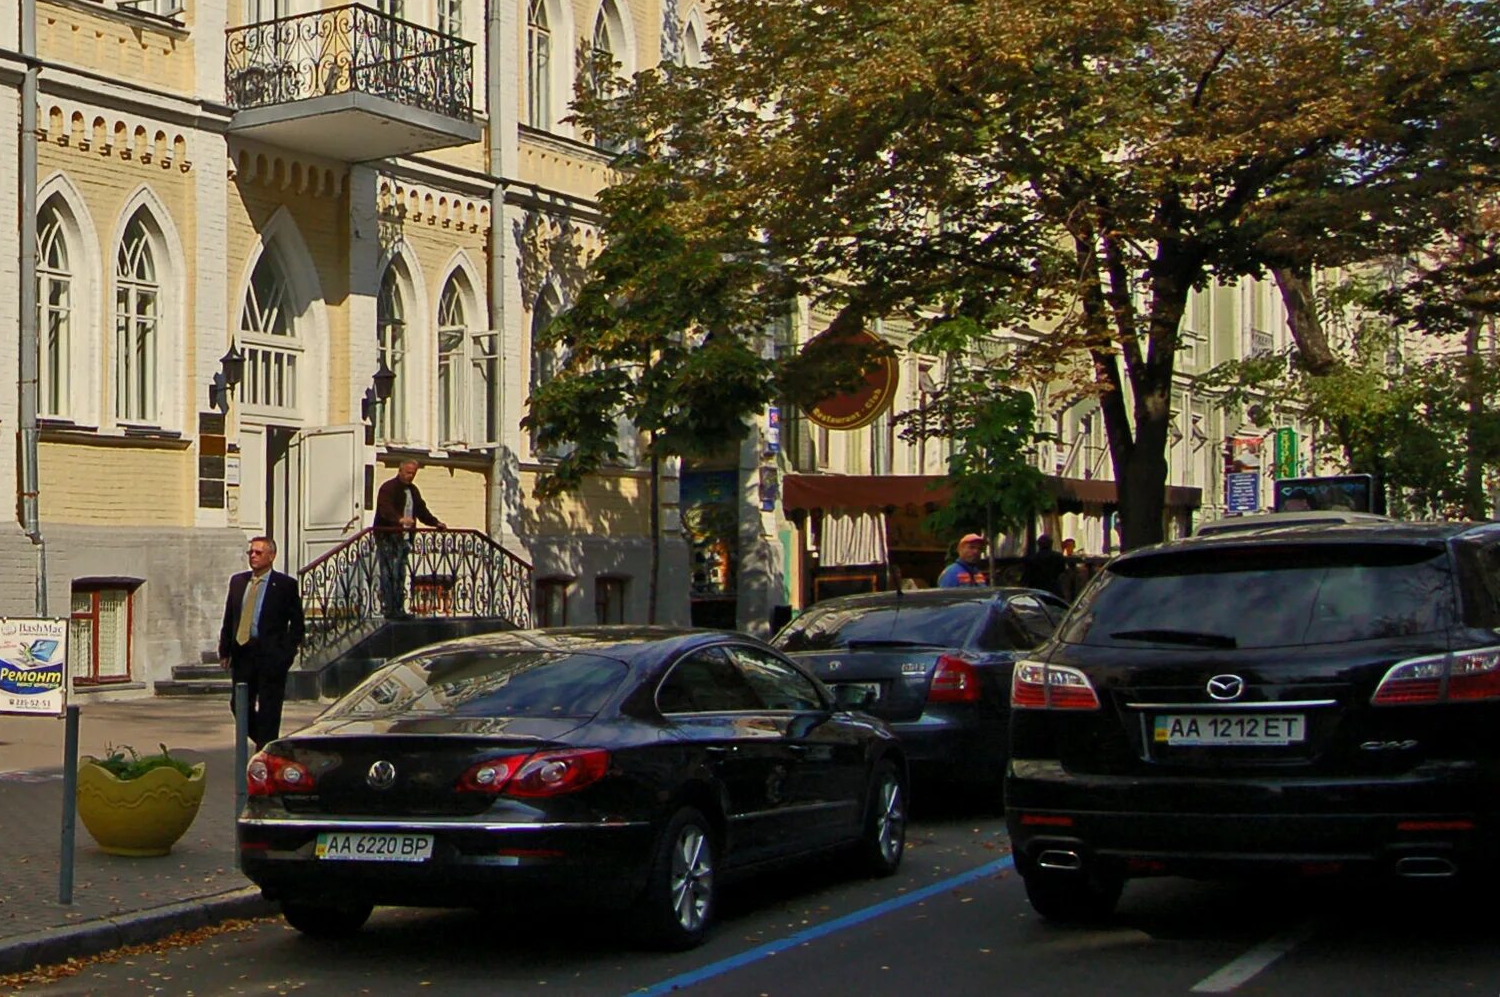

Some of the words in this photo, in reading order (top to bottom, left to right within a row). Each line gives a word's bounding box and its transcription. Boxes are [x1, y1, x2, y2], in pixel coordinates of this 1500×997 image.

[0, 667, 61, 683] Ремонт
[1170, 718, 1200, 737] AA
[1208, 718, 1259, 738] 1212
[1264, 718, 1298, 738] ET
[327, 836, 351, 854] AA
[355, 836, 398, 854] 6220
[401, 837, 429, 855] BP
